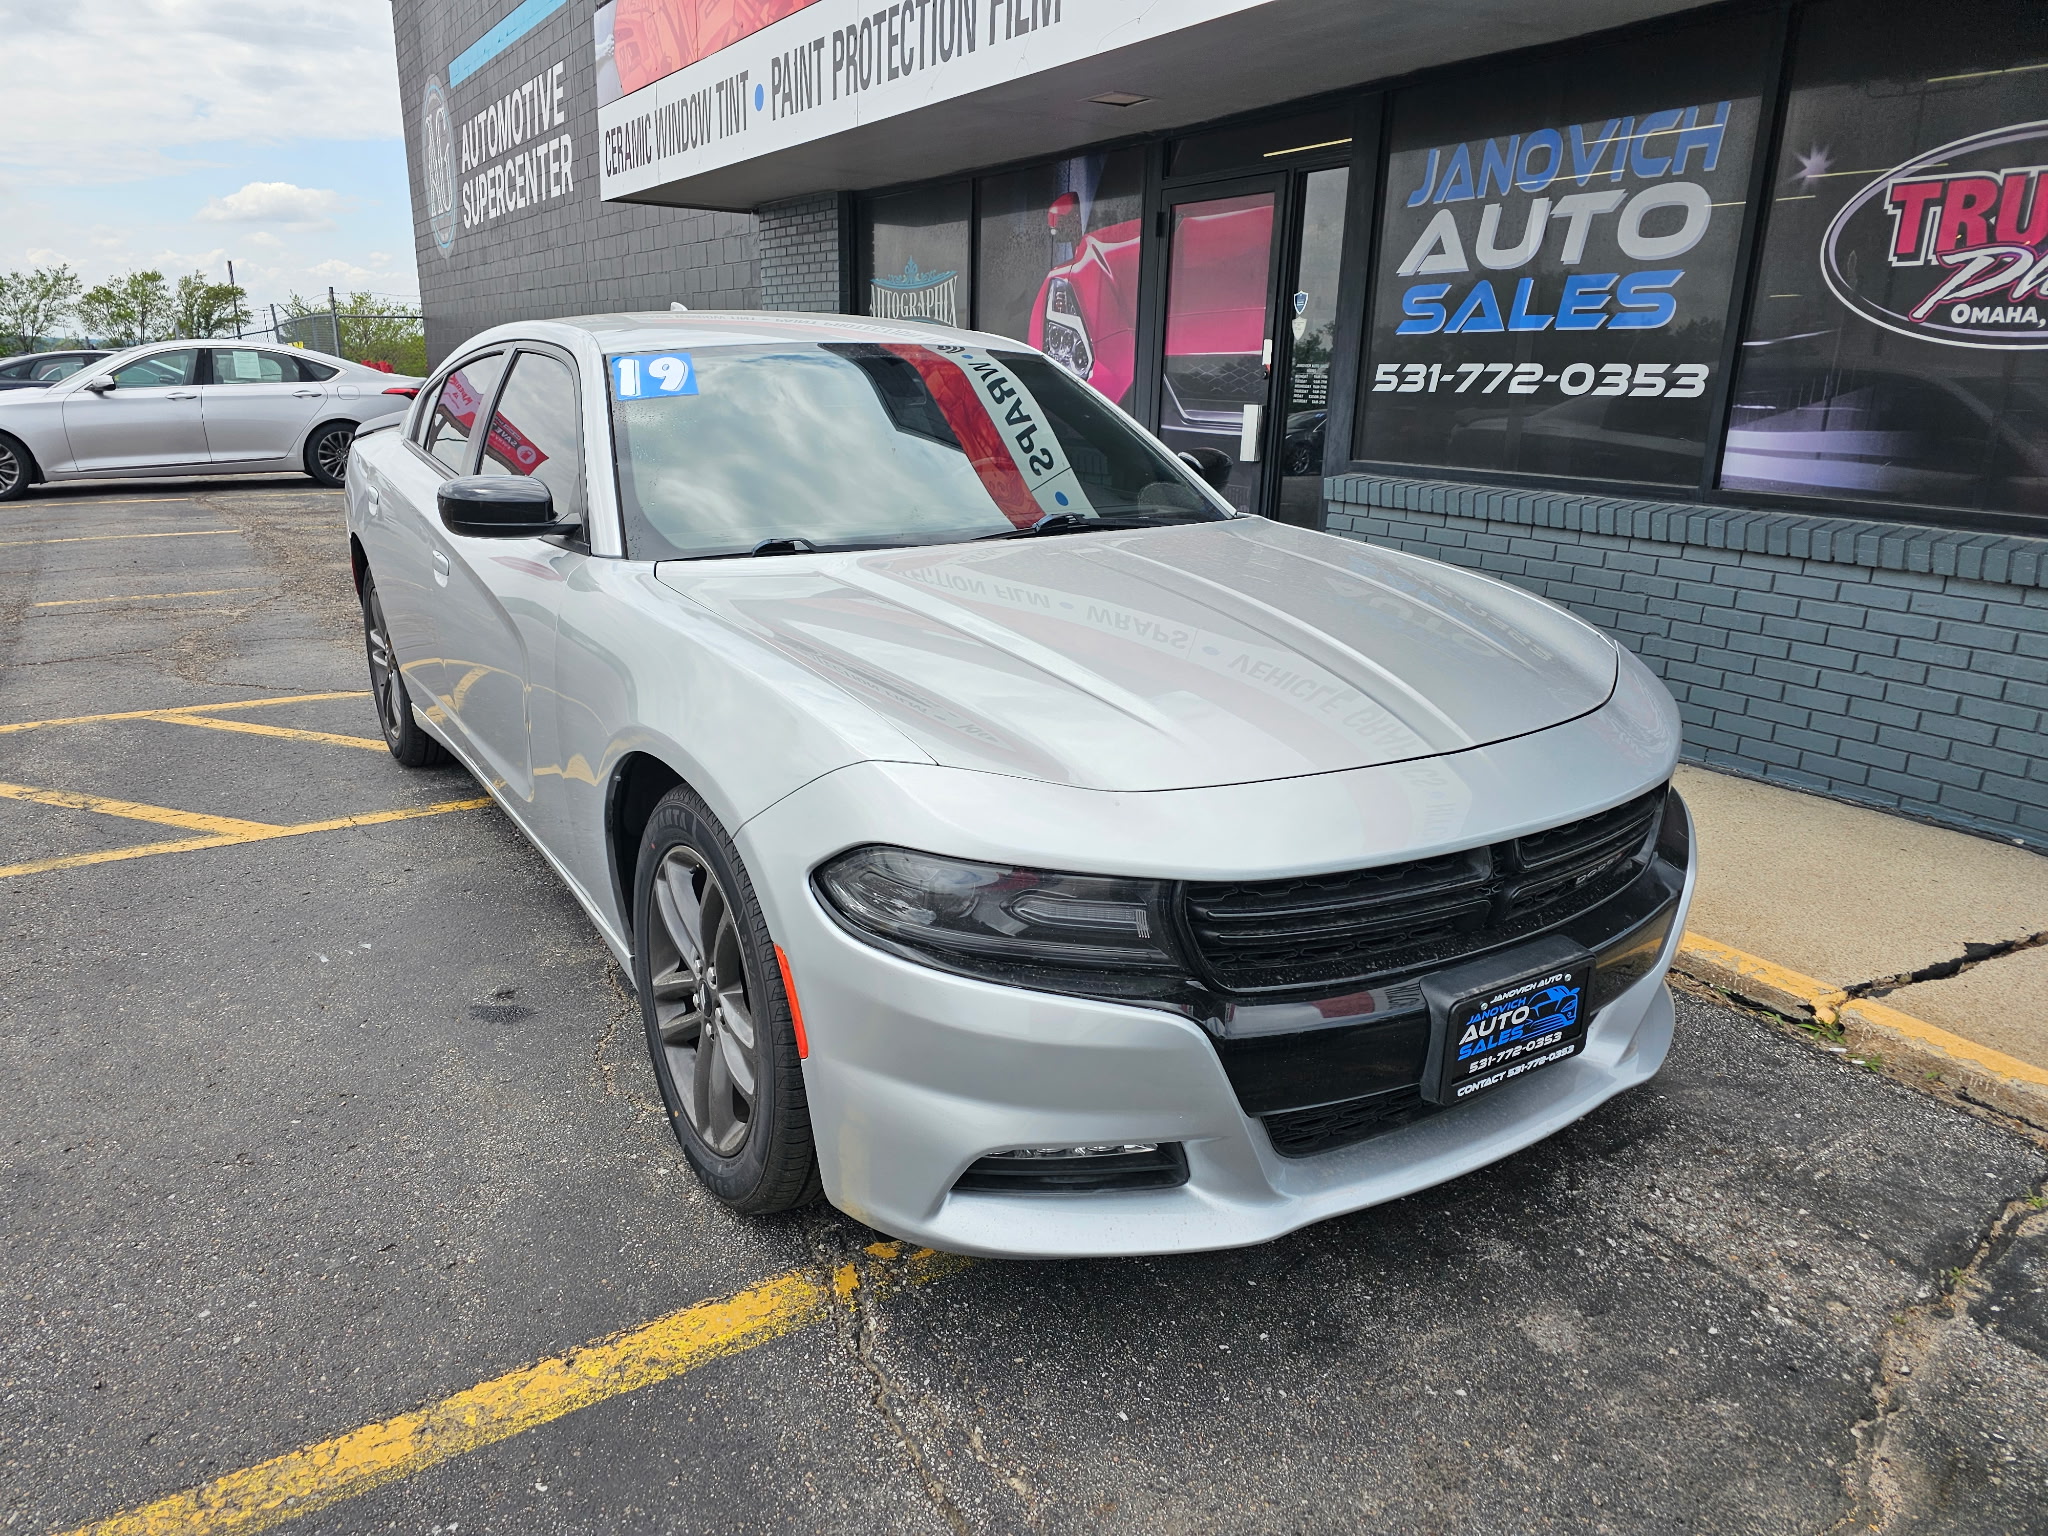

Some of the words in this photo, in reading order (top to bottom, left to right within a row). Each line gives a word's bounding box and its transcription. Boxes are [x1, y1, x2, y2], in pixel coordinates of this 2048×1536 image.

[605, 113, 651, 177] CERAMIC
[655, 87, 712, 160] WINDOW
[716, 70, 749, 139] TINT
[772, 36, 825, 121] PAINT
[832, 0, 977, 101] PROTECTION
[461, 61, 565, 174] AUTOMOTIVE
[1407, 101, 1731, 208] JANOVICH
[462, 134, 574, 229] SUPERCENTER
[1396, 181, 1712, 276] AUTO
[869, 275, 958, 328] AUTOGRAPHIX
[1396, 269, 1686, 335] SALES
[1950, 303, 2046, 328] OMAHA,
[618, 357, 688, 396] 19
[1372, 362, 1710, 398] 531-772-0353
[1489, 981, 1537, 1005] JANOVICH
[1536, 973, 1563, 988] AUTO
[1458, 1005, 1530, 1046] AUTO
[1466, 996, 1527, 1026] JANOVICH
[1457, 1025, 1525, 1061] SALES
[1468, 1031, 1563, 1074] 531-772-0353
[1457, 1070, 1506, 1097] CONTACT
